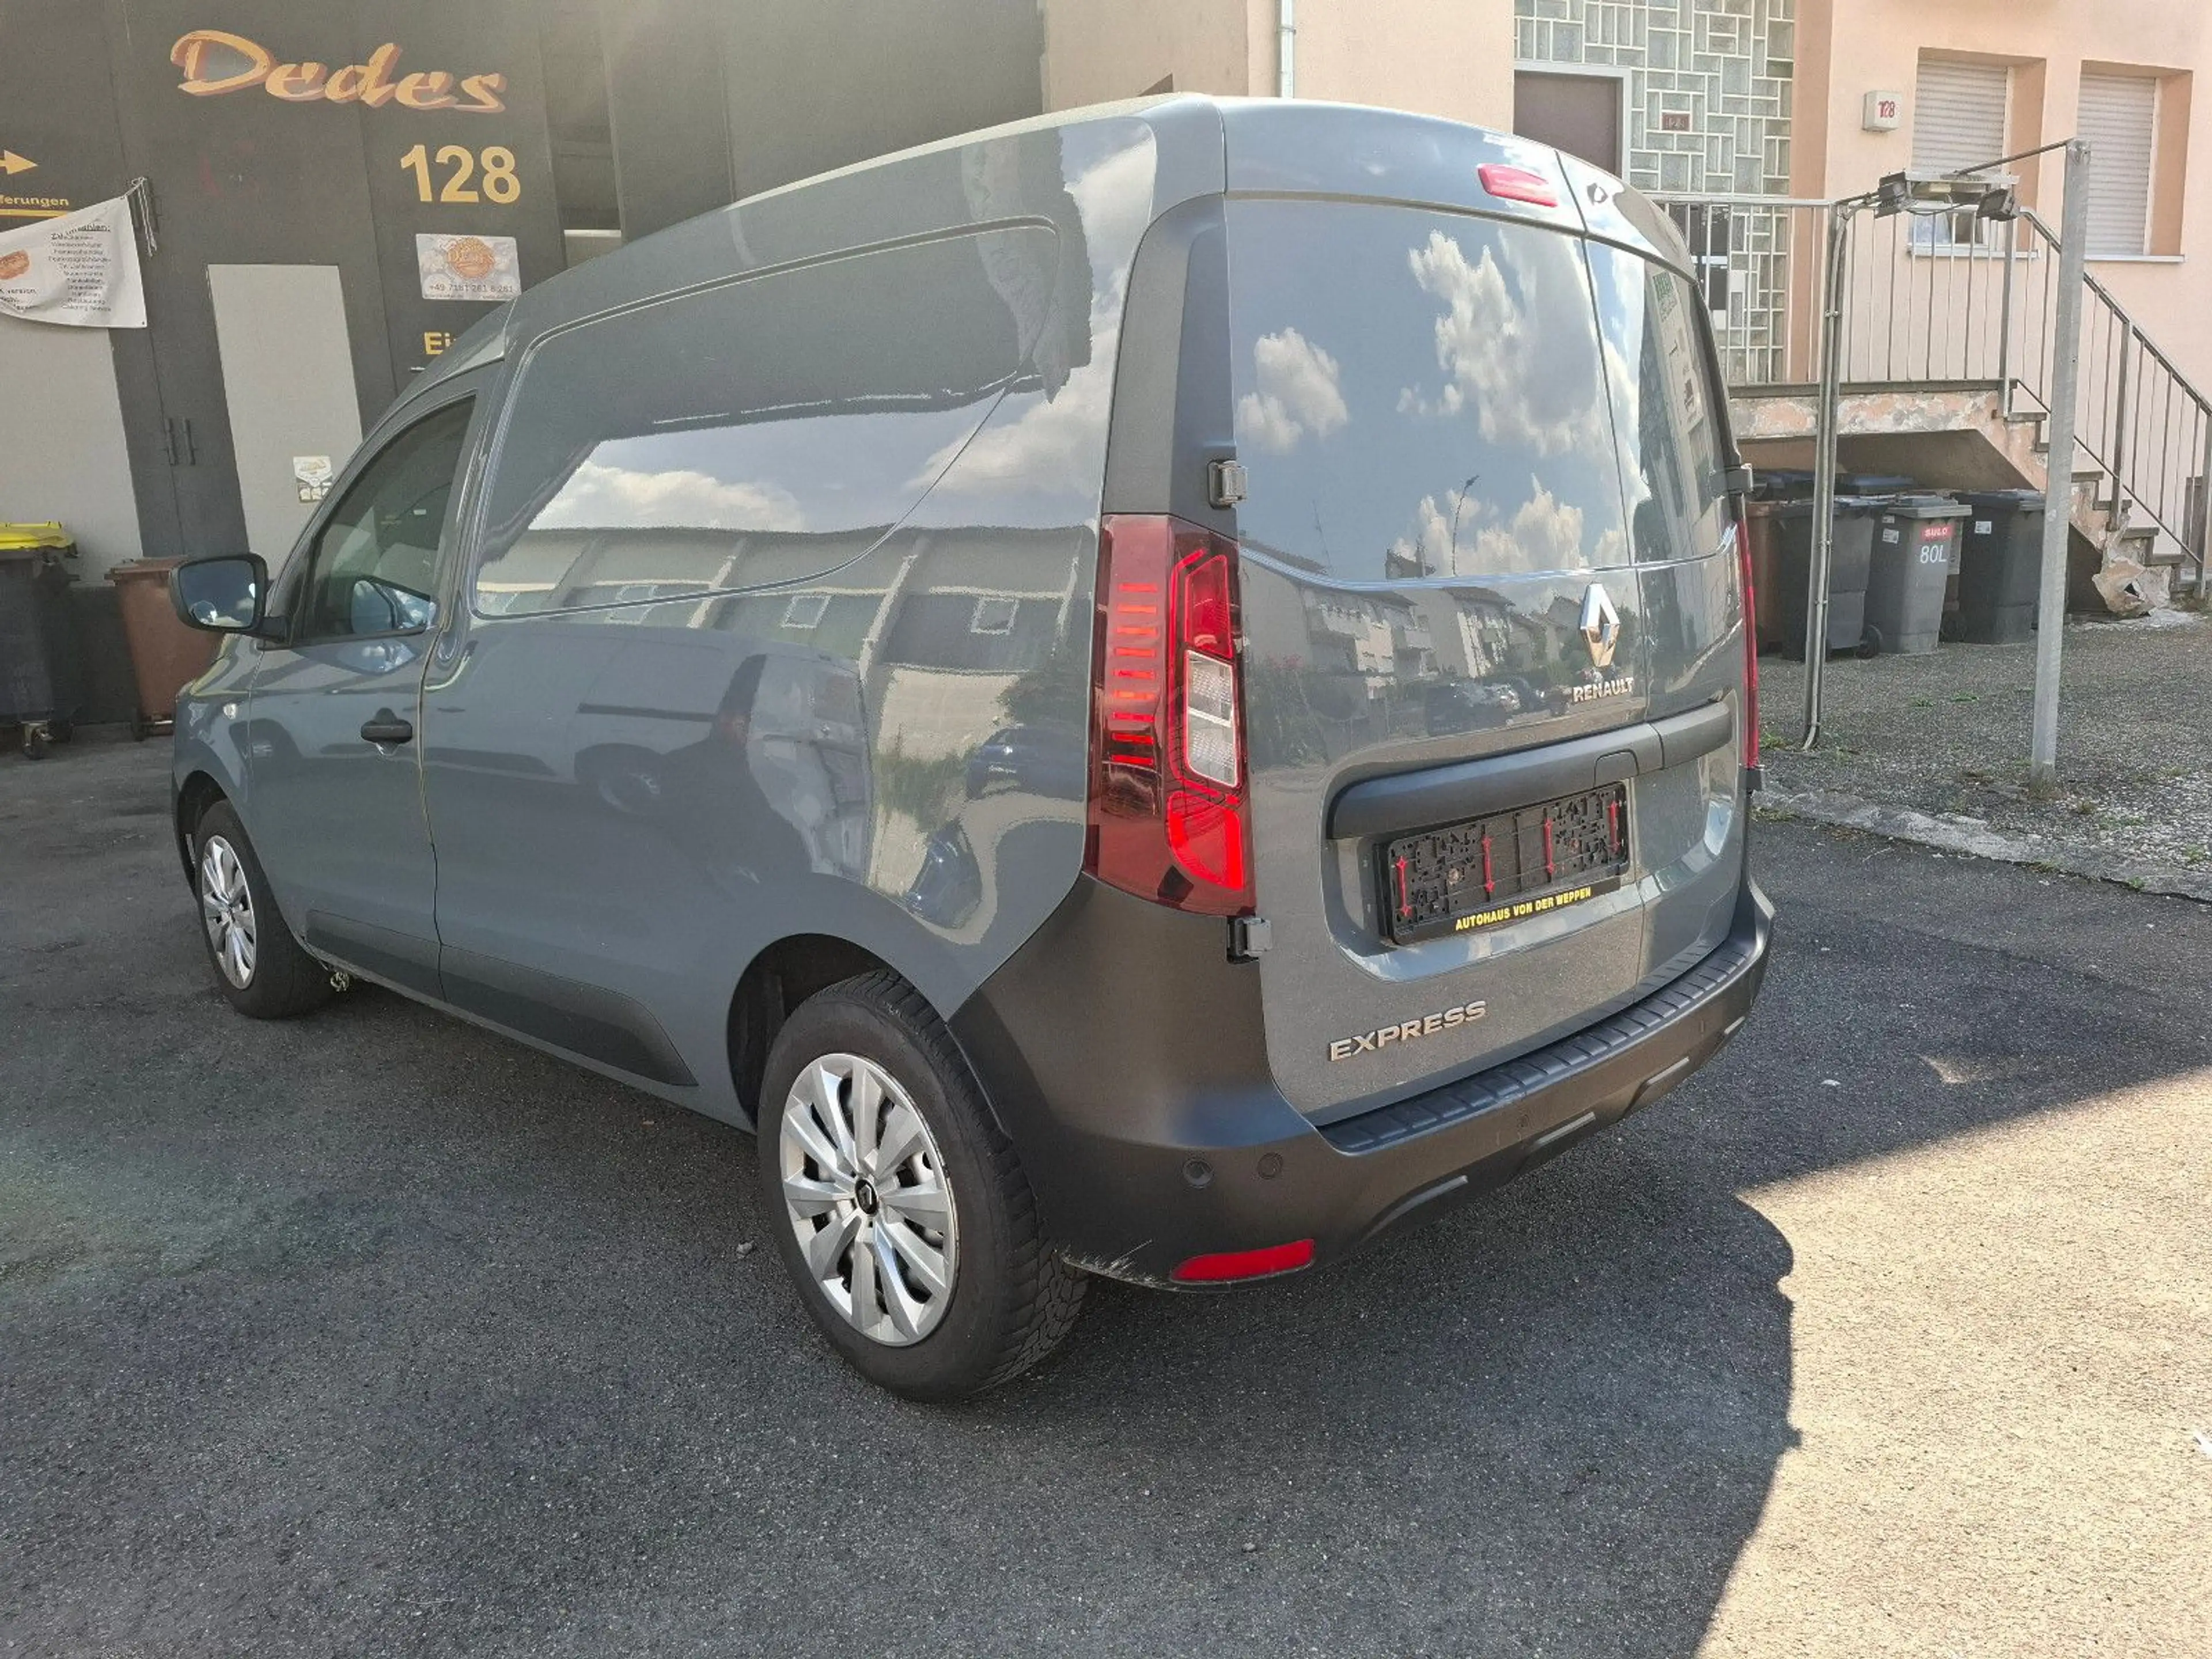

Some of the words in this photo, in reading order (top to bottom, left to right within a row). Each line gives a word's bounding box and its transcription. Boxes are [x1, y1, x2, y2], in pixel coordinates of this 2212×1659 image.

[171, 30, 507, 112] Dedes
[400, 145, 520, 203] 128
[1920, 545, 1947, 563] 80L
[1573, 677, 1634, 703] RENAULT
[1456, 908, 1510, 931] AUTOHAUS
[1513, 903, 1533, 916] VON
[1535, 897, 1554, 911] DER
[1556, 887, 1592, 906] WEPPEN
[1330, 1001, 1486, 1061] EXPRESS
